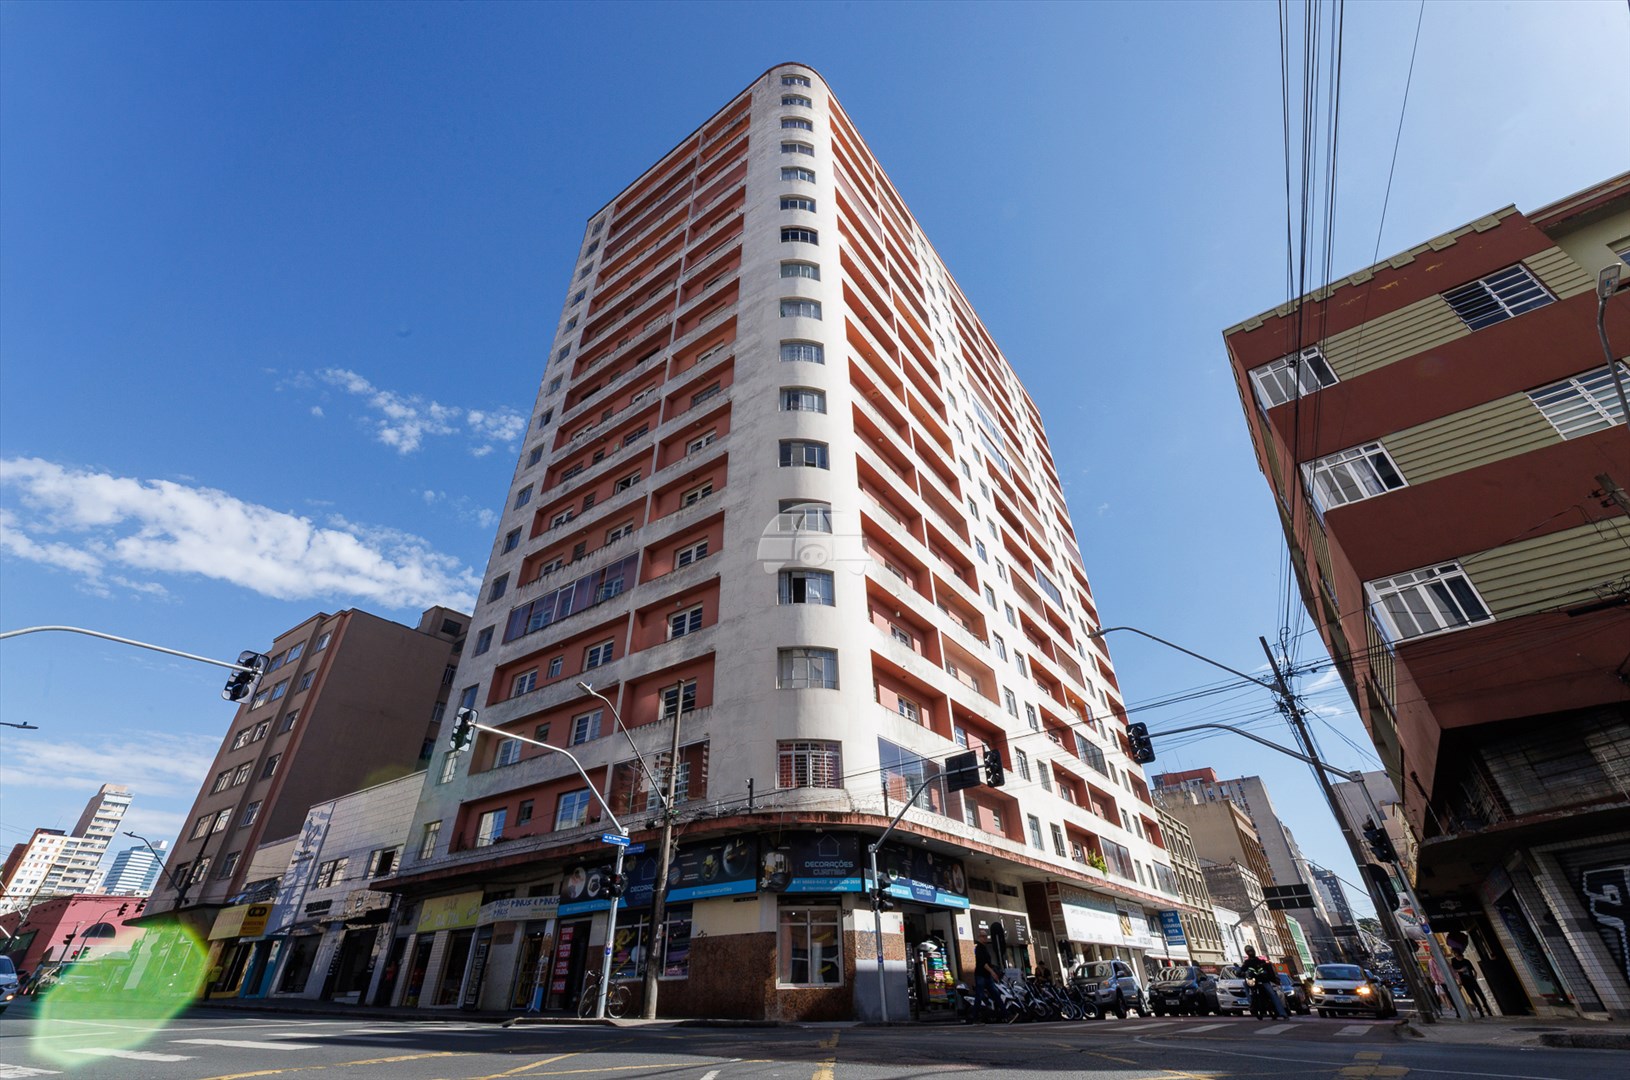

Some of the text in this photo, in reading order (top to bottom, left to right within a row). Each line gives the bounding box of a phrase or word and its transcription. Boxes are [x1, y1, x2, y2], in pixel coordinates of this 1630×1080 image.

[804, 860, 854, 869] DECORAÇÕES
[511, 898, 531, 908] PINUS
[539, 897, 560, 906] PINUS
